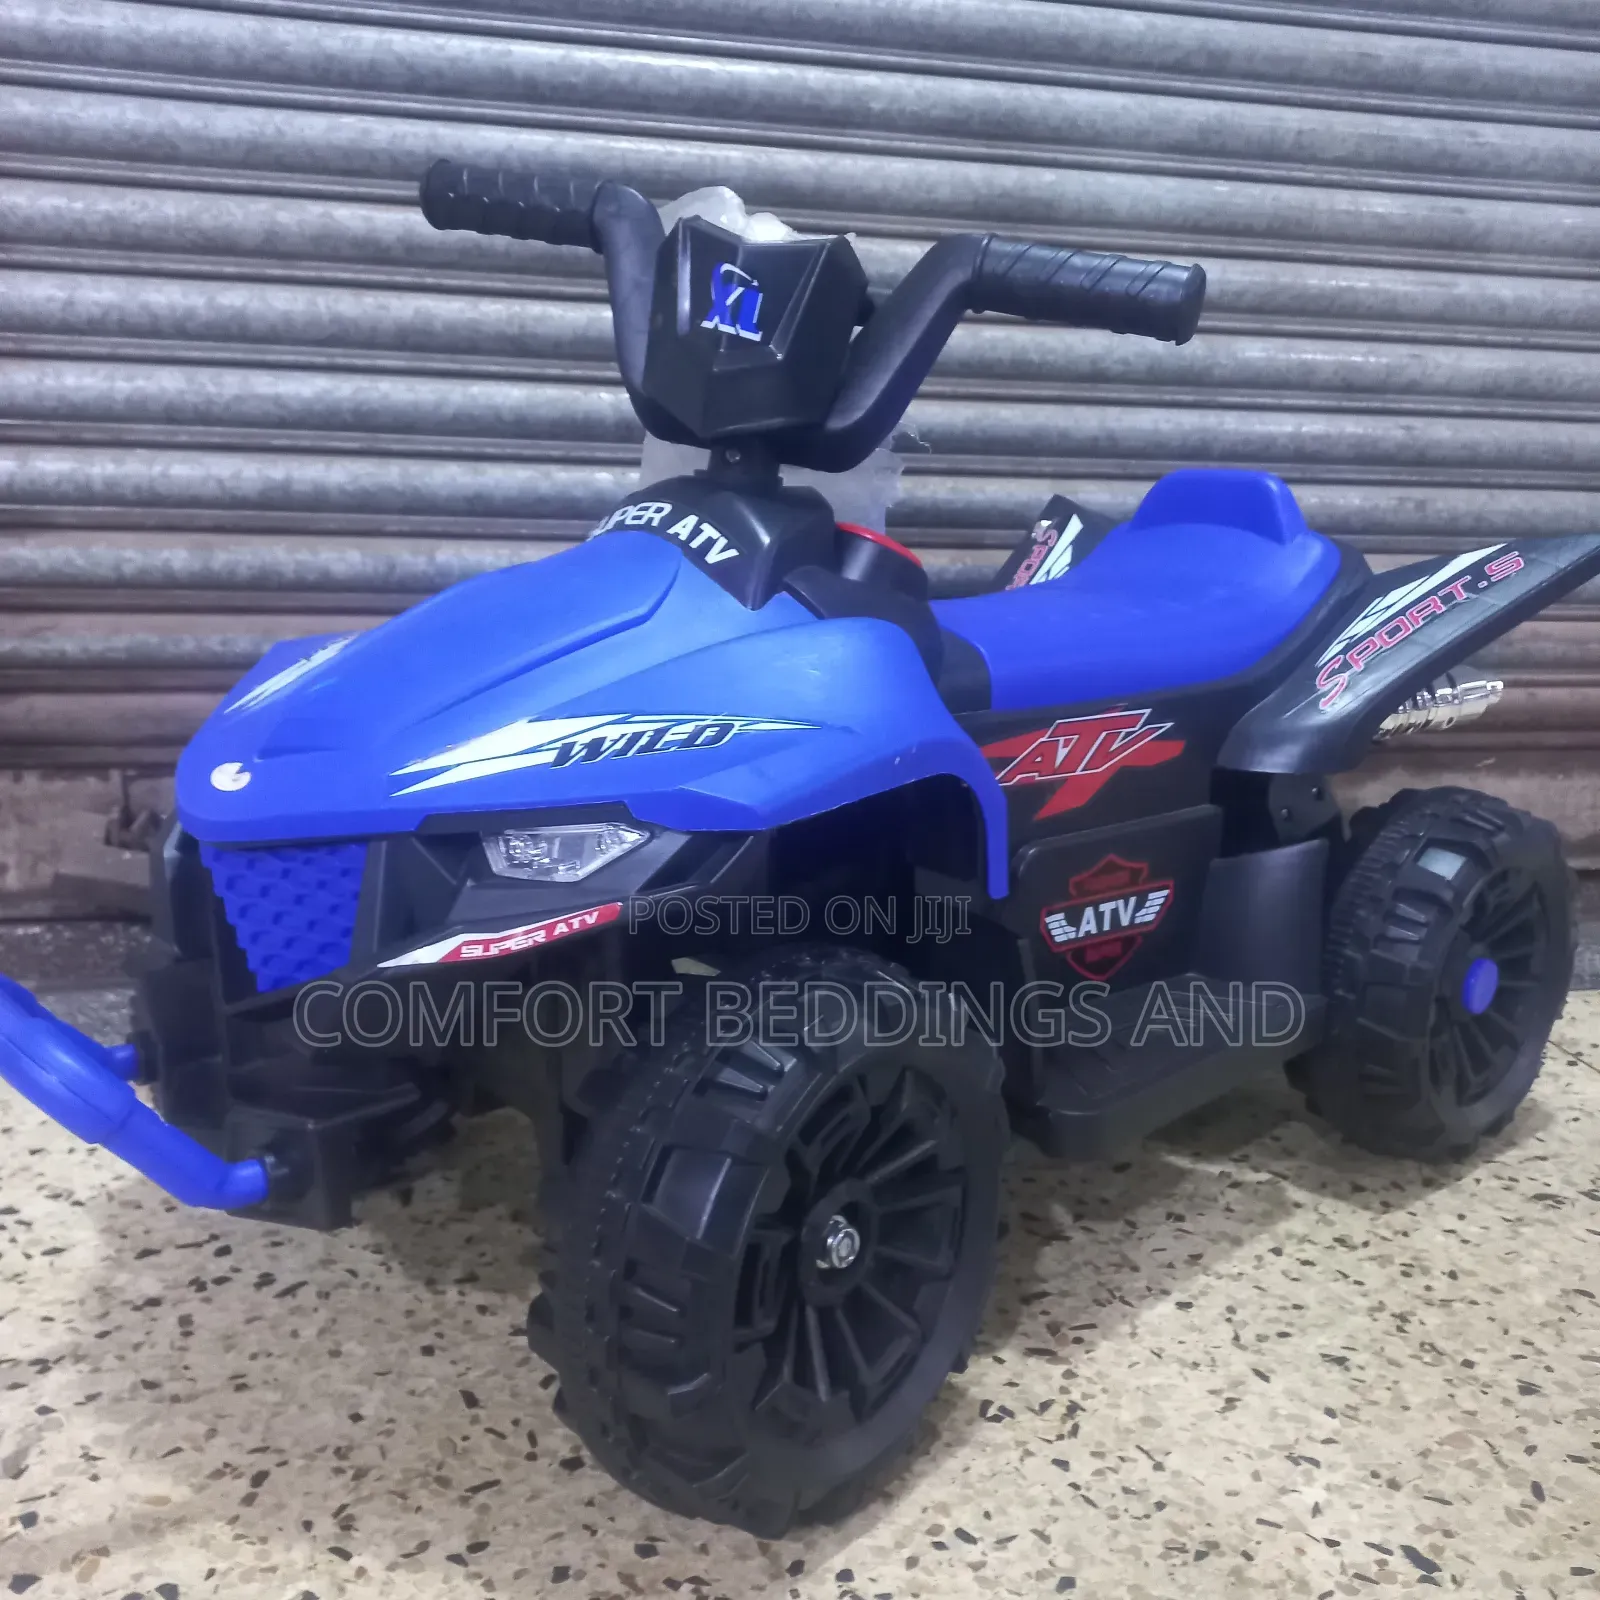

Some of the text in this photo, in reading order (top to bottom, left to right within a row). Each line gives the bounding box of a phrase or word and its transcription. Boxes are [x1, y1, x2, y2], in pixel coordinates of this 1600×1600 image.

[666, 514, 740, 564] ATV
[549, 721, 738, 770] WILD
[995, 707, 1175, 786] ATV
[459, 911, 599, 958] SUPER ATV
[1077, 896, 1137, 938] ATV
